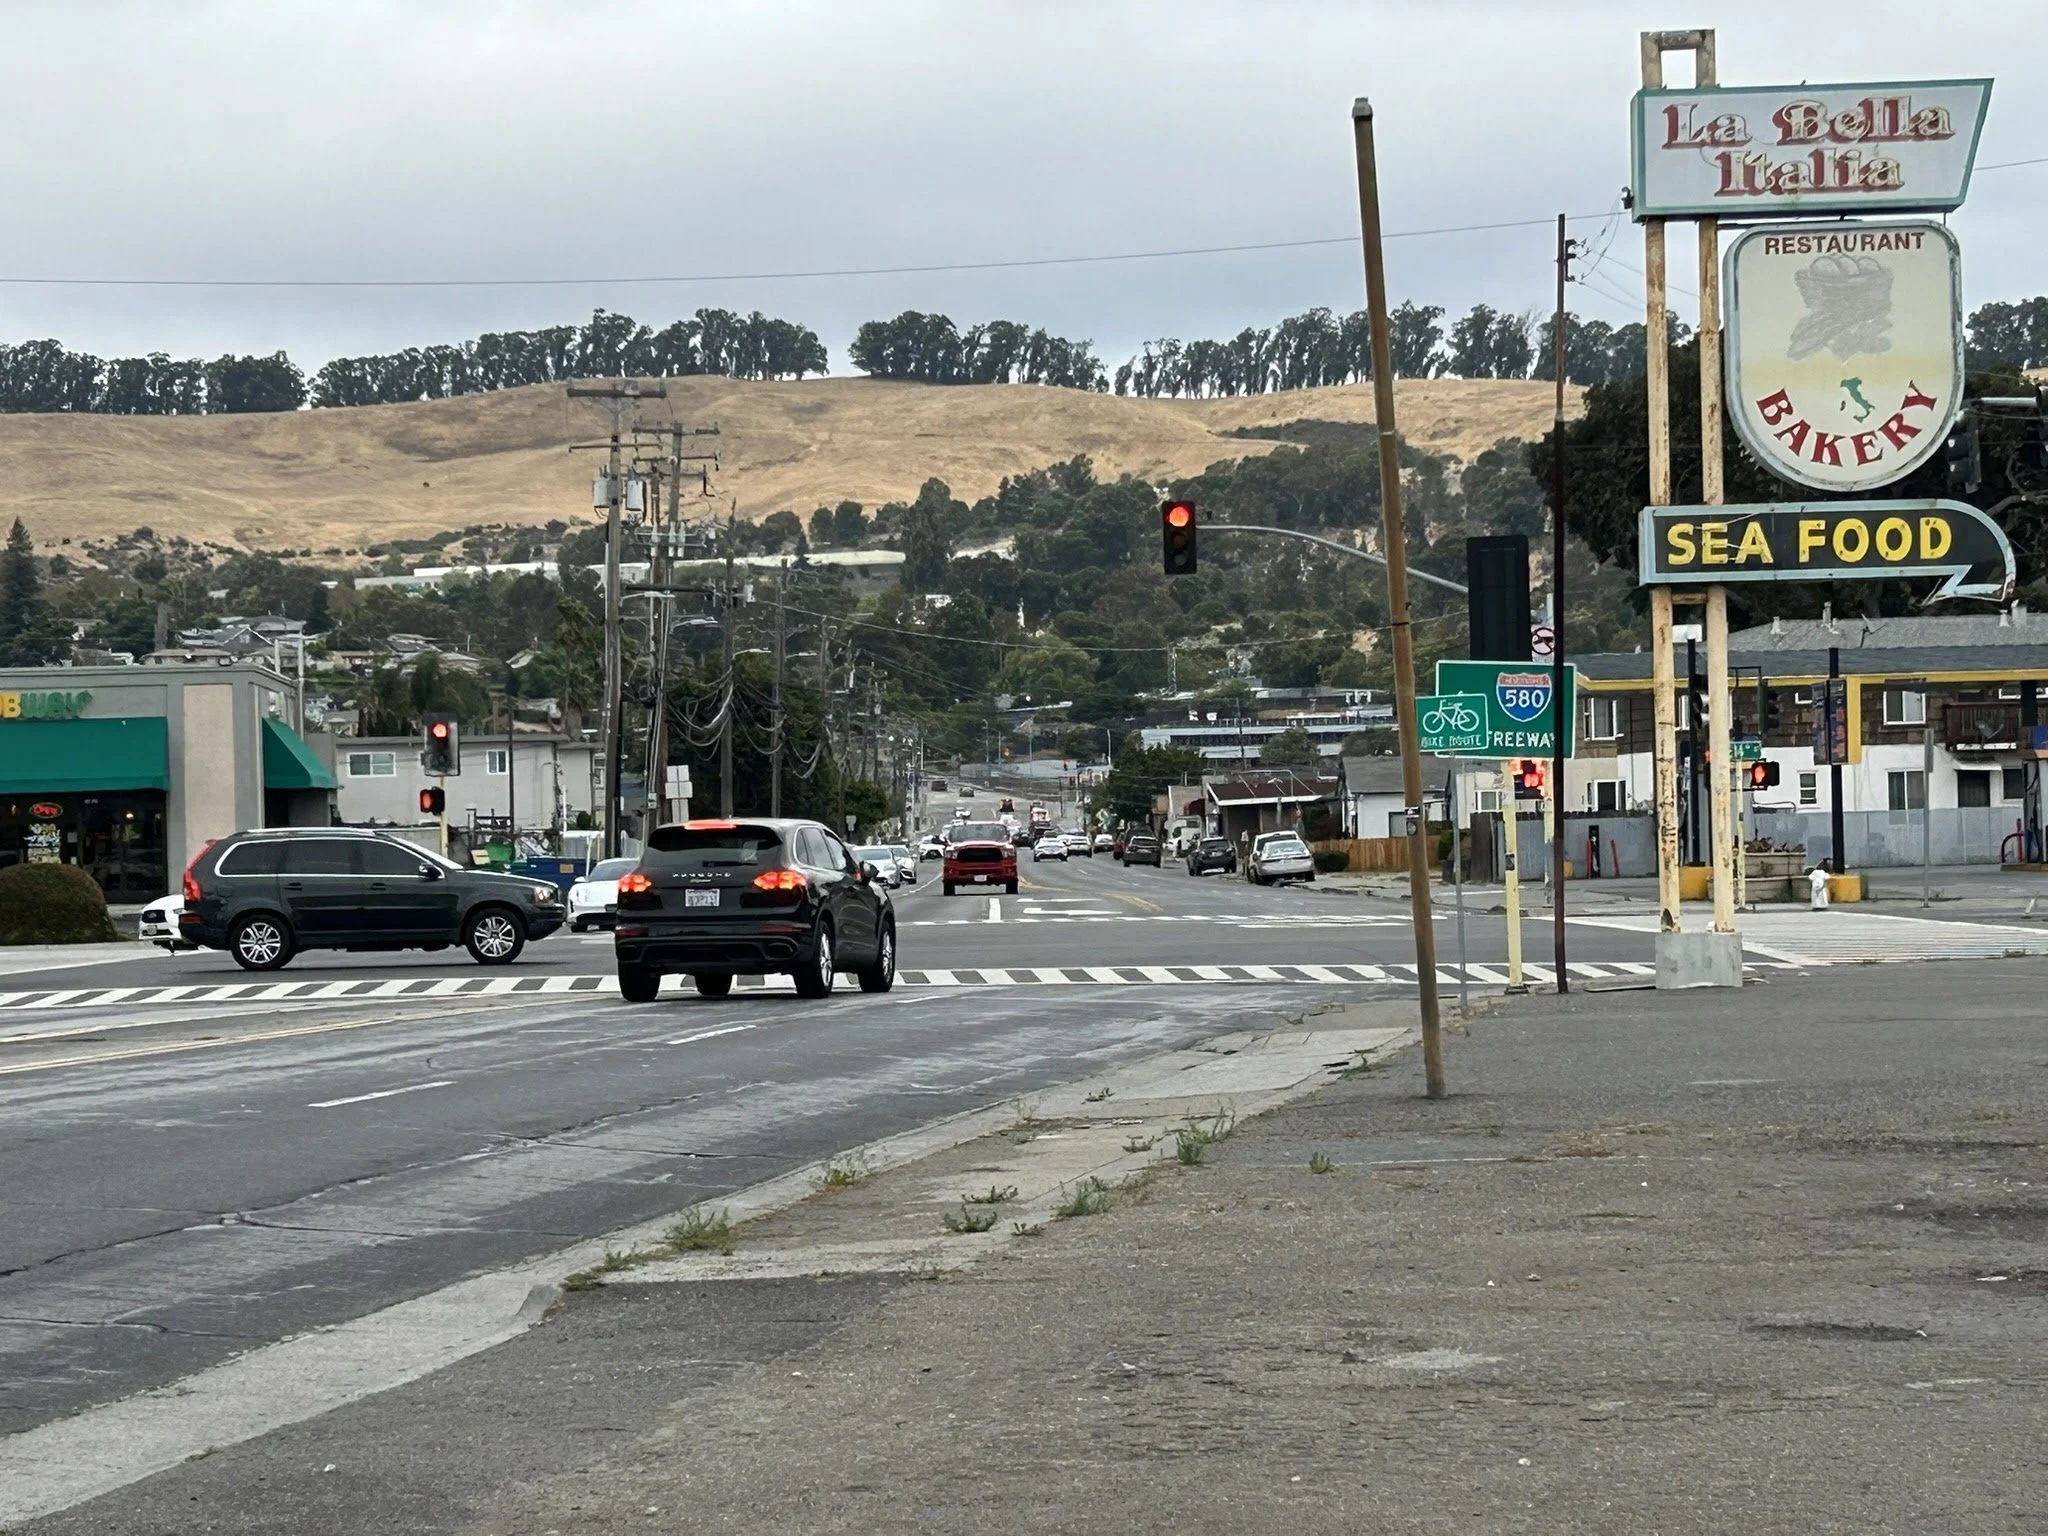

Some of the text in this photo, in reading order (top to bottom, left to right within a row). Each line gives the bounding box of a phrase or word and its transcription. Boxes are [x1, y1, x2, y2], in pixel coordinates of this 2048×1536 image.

[1663, 95, 1956, 149] La Bella
[1714, 147, 1905, 197] Italia
[1764, 231, 1925, 255] RESTAURANT
[1756, 380, 1938, 467] BAKERY
[1667, 516, 1952, 565] SEA FOOD
[0, 689, 93, 719] BWAY
[1505, 689, 1545, 709] 580
[1420, 735, 1444, 748] BIKE
[1488, 731, 1555, 749] REEWA
